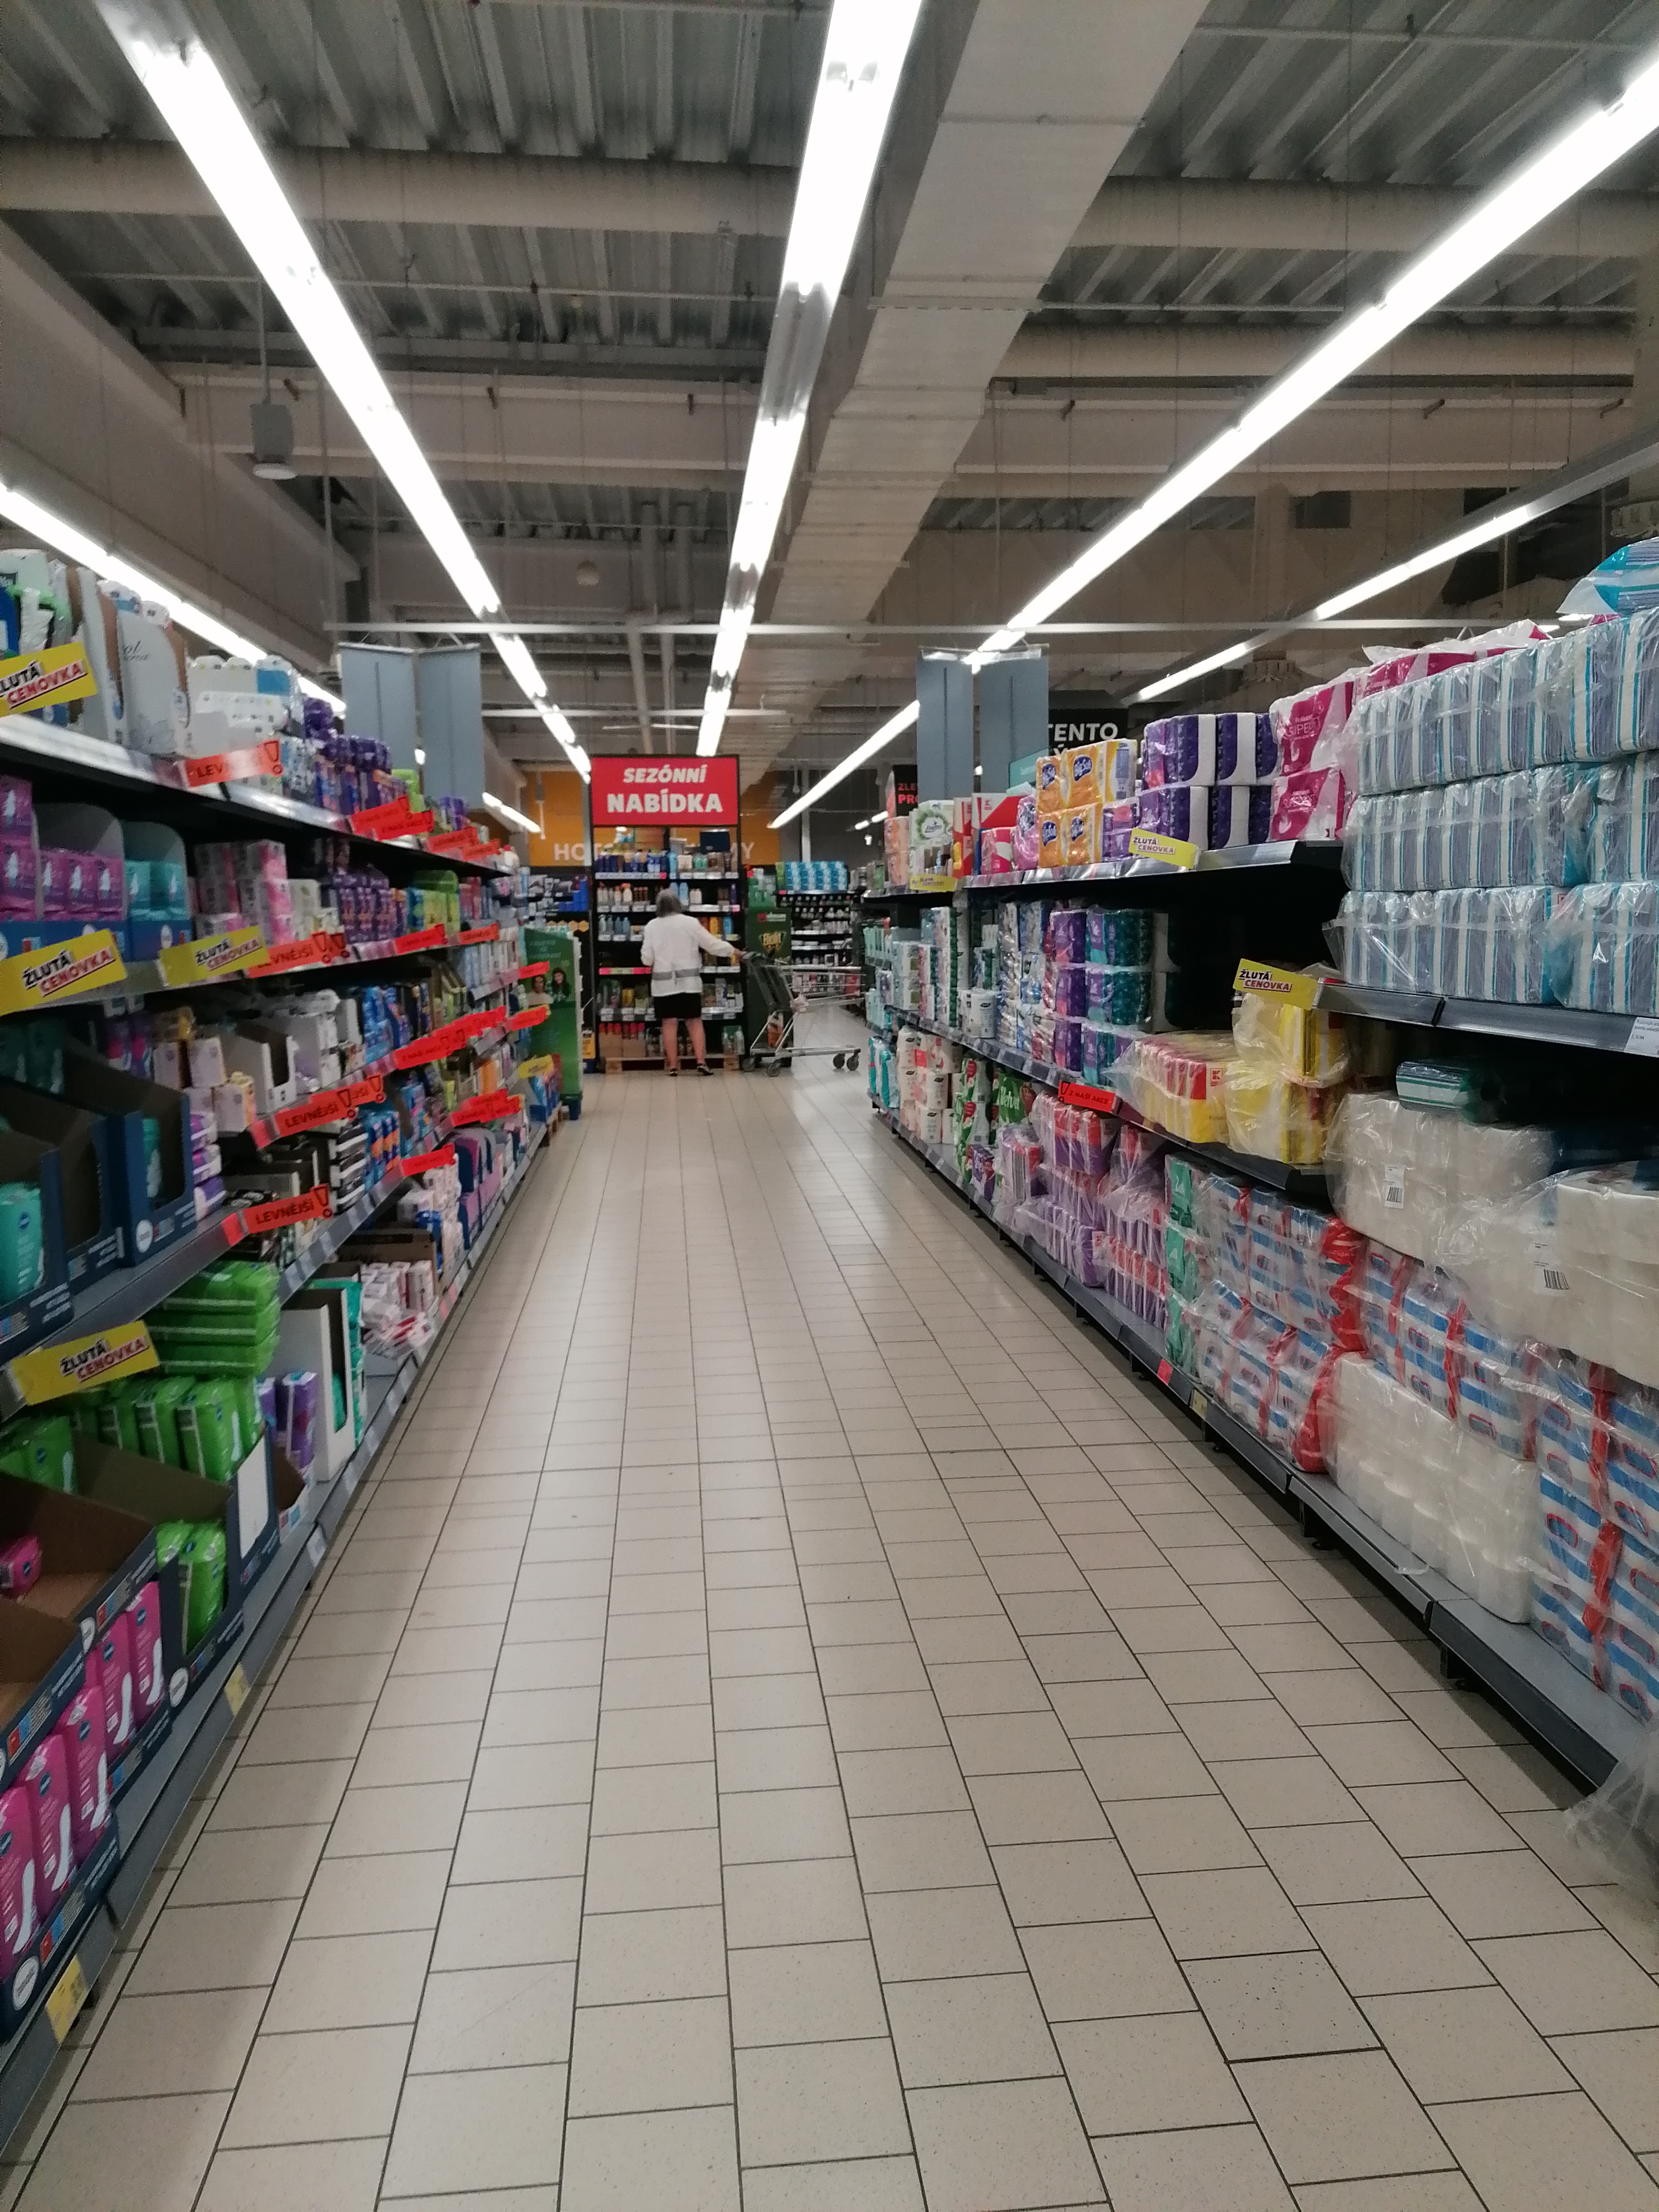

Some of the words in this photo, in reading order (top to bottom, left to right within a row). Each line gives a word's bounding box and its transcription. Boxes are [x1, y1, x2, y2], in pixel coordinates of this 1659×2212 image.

[0, 660, 40, 691] LUTÁ
[8, 662, 82, 703] CENOVKA
[1048, 722, 1118, 741] ENTO
[623, 764, 707, 783] SEZÓNNÍ
[607, 788, 723, 813] NABÍDKA
[23, 950, 71, 985] ŽLUTÁ
[40, 950, 109, 992] CENOVKA
[1240, 968, 1271, 980] ŽLUTÁ
[1245, 980, 1289, 990] CENOVKA
[1092, 1095, 1108, 1104] AKCE
[255, 1198, 314, 1224] LEVNĚJŠÍ
[60, 1339, 107, 1373] ŽLUTÁ
[77, 1338, 144, 1378] CENOVKA
